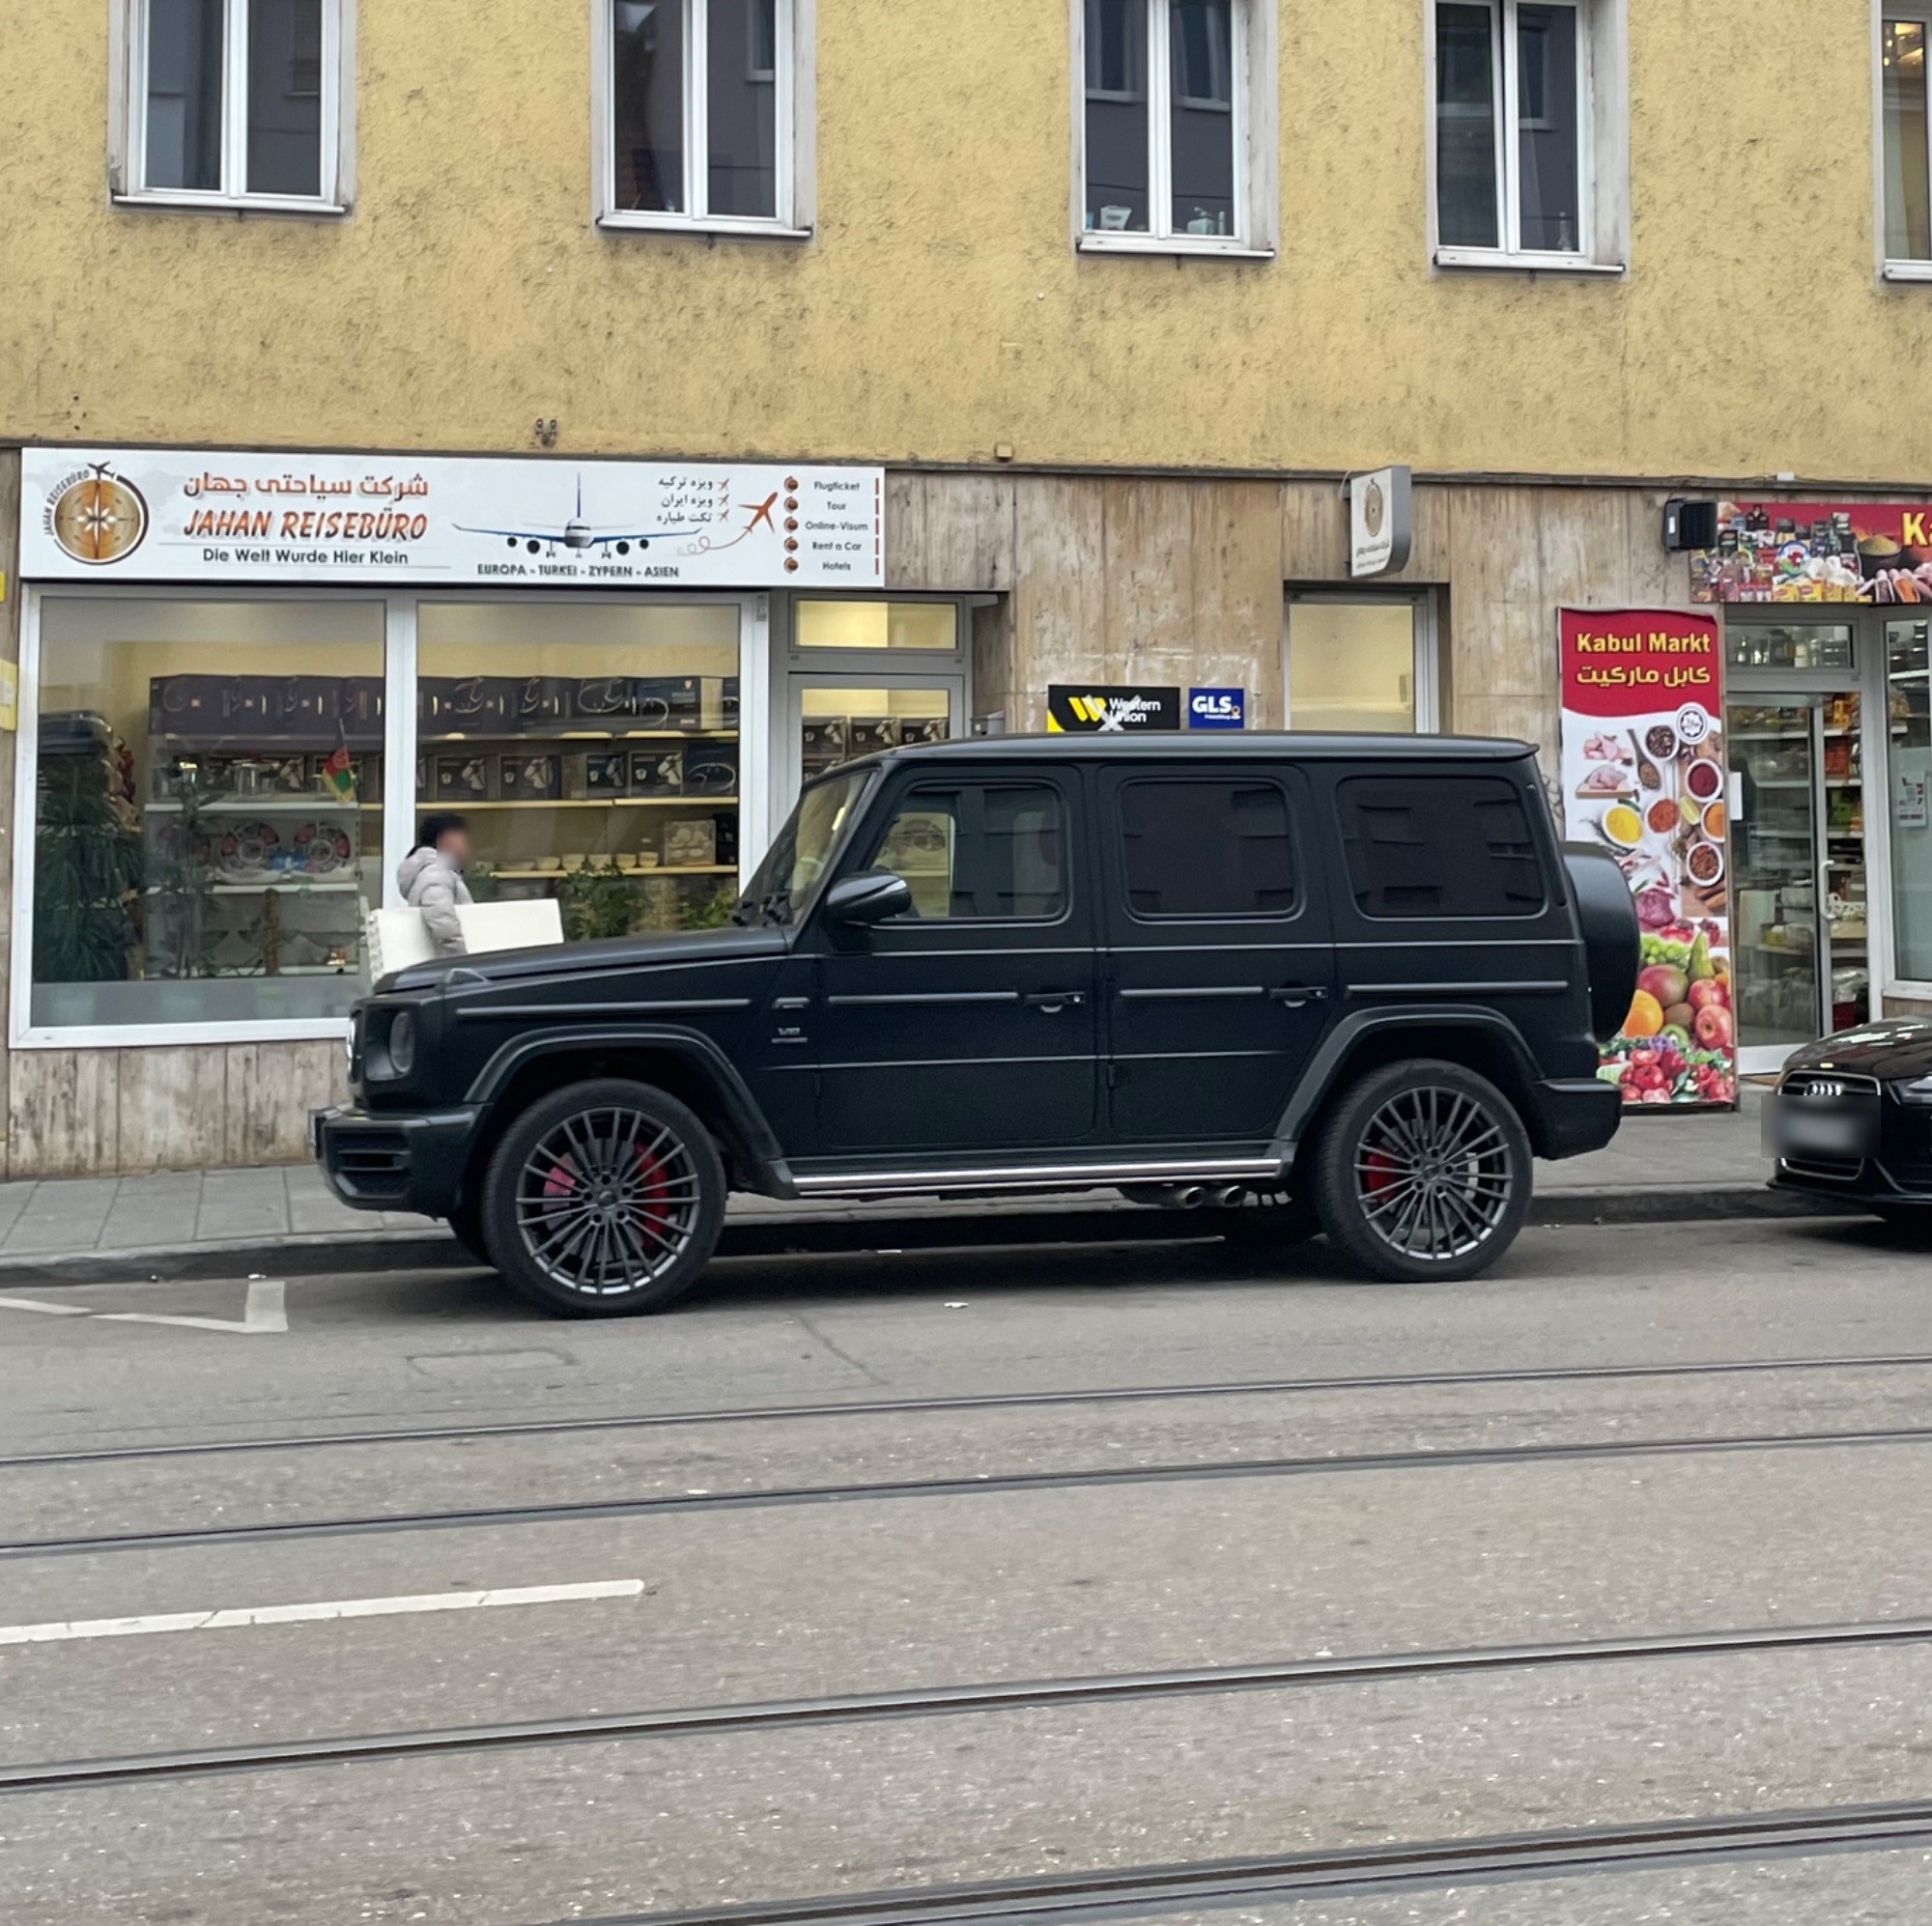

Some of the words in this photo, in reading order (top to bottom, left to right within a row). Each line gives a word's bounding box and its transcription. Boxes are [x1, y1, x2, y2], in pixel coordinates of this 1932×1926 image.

[184, 471, 248, 498] جهان
[813, 481, 860, 493] Flugticket
[827, 501, 846, 510] Tour
[184, 509, 272, 537] JAHAN
[279, 507, 428, 541] REISEBÜRO
[805, 521, 868, 530] Online-Visum
[1903, 512, 1932, 547] K
[812, 541, 833, 551] Rent
[844, 542, 862, 551] Car
[203, 548, 230, 562] Die
[235, 549, 270, 562] Welt
[275, 550, 328, 563] Wurde
[333, 551, 365, 564] Hier
[370, 552, 408, 565] Klein
[477, 564, 527, 576] EUROPA
[588, 565, 633, 577] ZYPERN
[644, 566, 679, 578] ASIEN
[1577, 633, 1641, 653] Kabul
[1648, 633, 1711, 653] Markt
